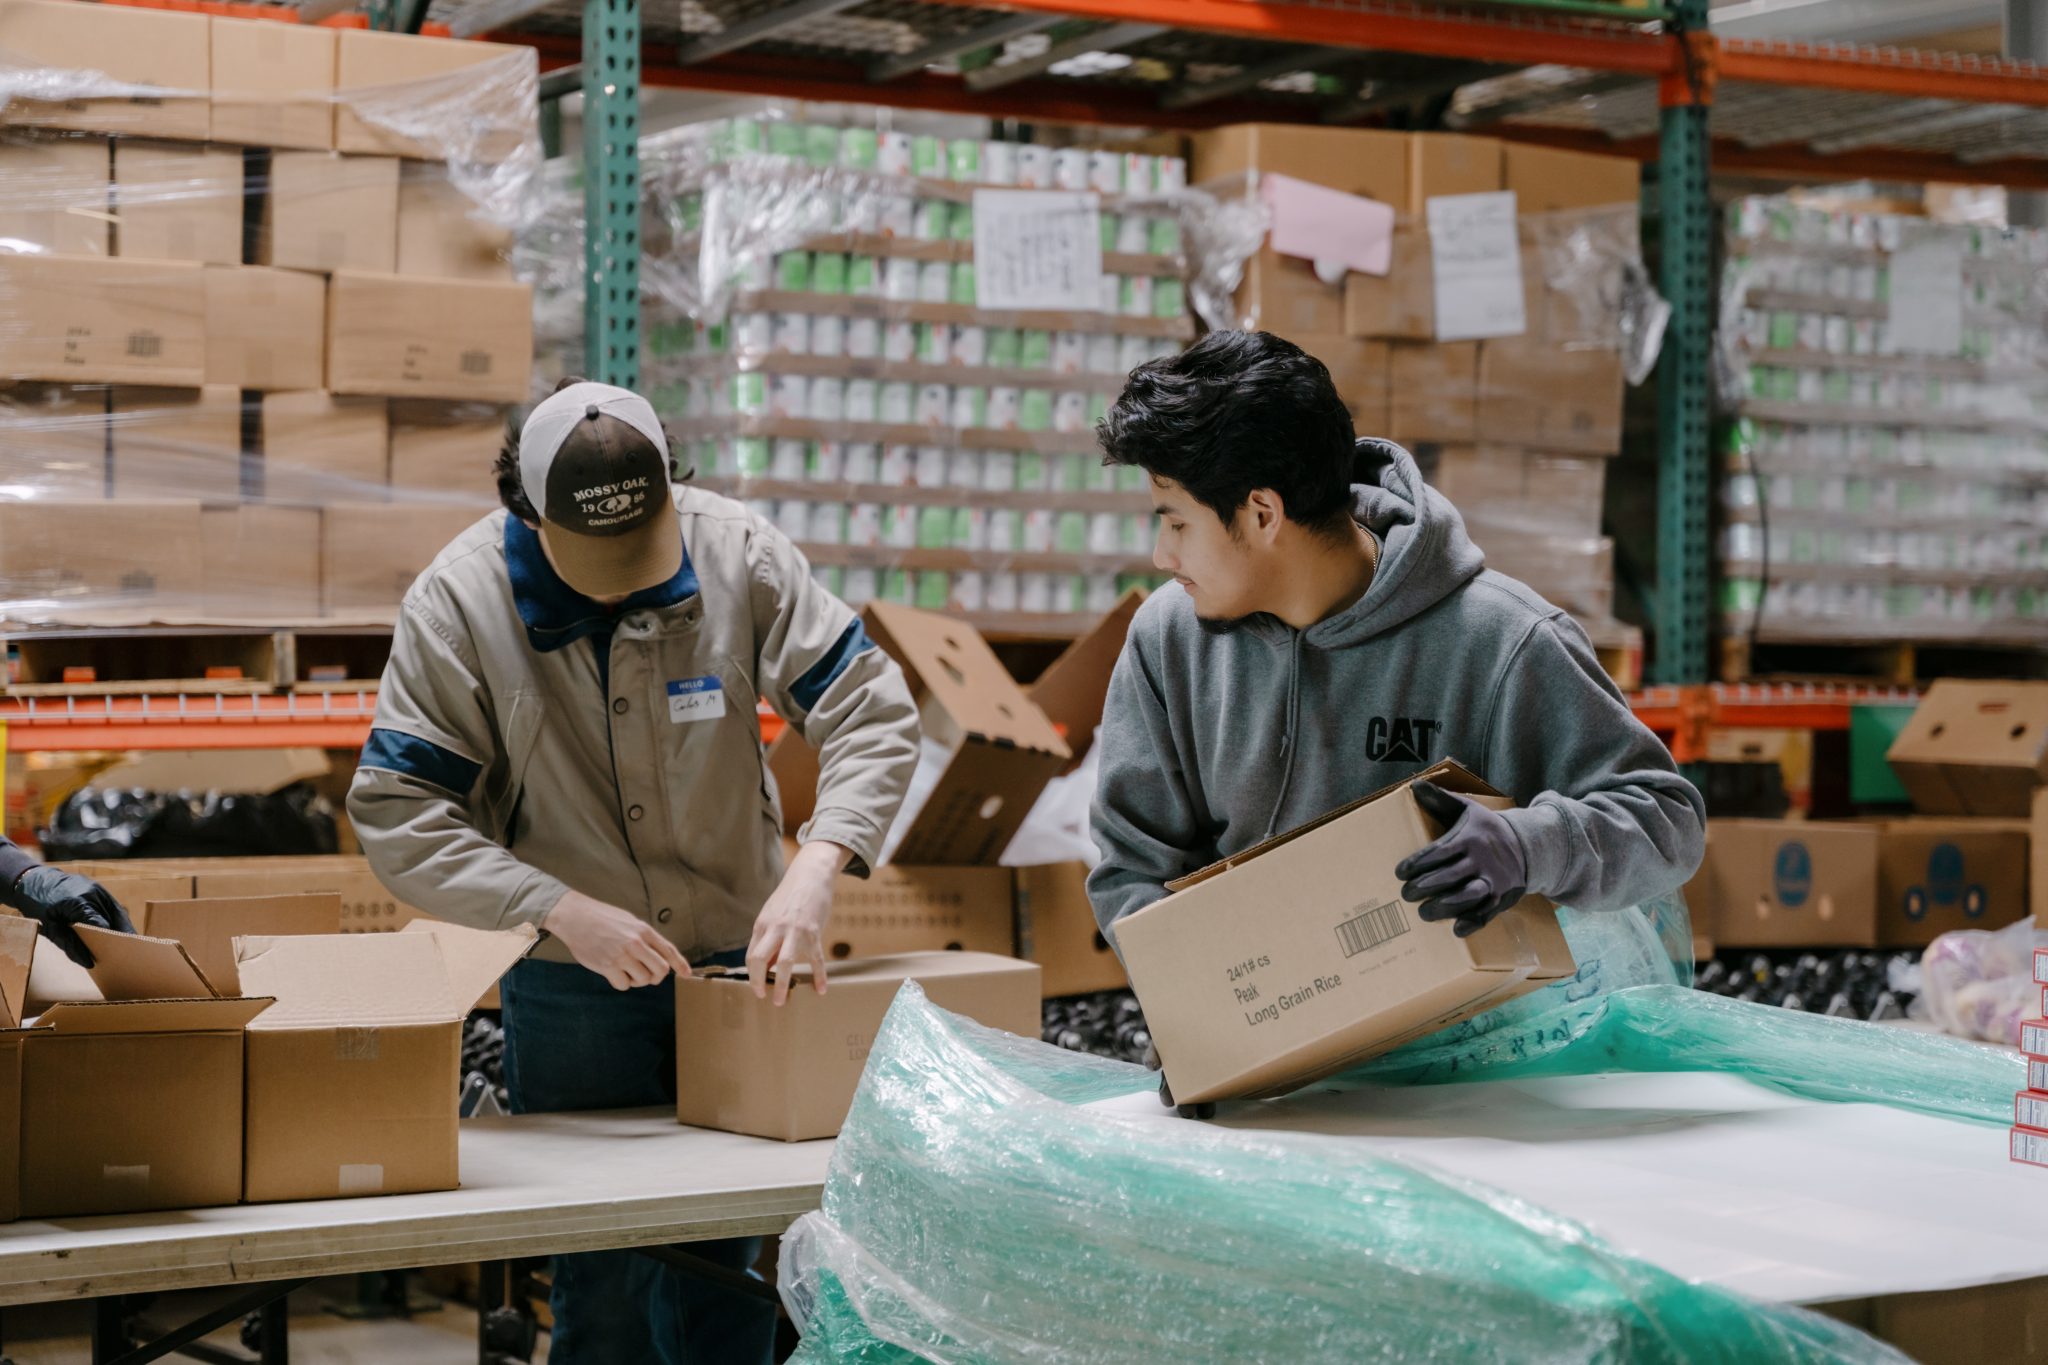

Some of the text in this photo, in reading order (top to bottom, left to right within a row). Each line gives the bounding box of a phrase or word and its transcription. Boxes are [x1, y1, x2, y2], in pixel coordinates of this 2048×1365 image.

[573, 482, 619, 502] MOSSY
[581, 490, 645, 513] 19 86
[588, 507, 643, 526] CAMOUFLAGE
[678, 679, 705, 690] HELLO
[1365, 716, 1436, 762] CAT
[1226, 955, 1271, 982] 24/1# cs
[1233, 982, 1260, 1005] Peak
[1244, 973, 1342, 1026] Long Grain Rice
